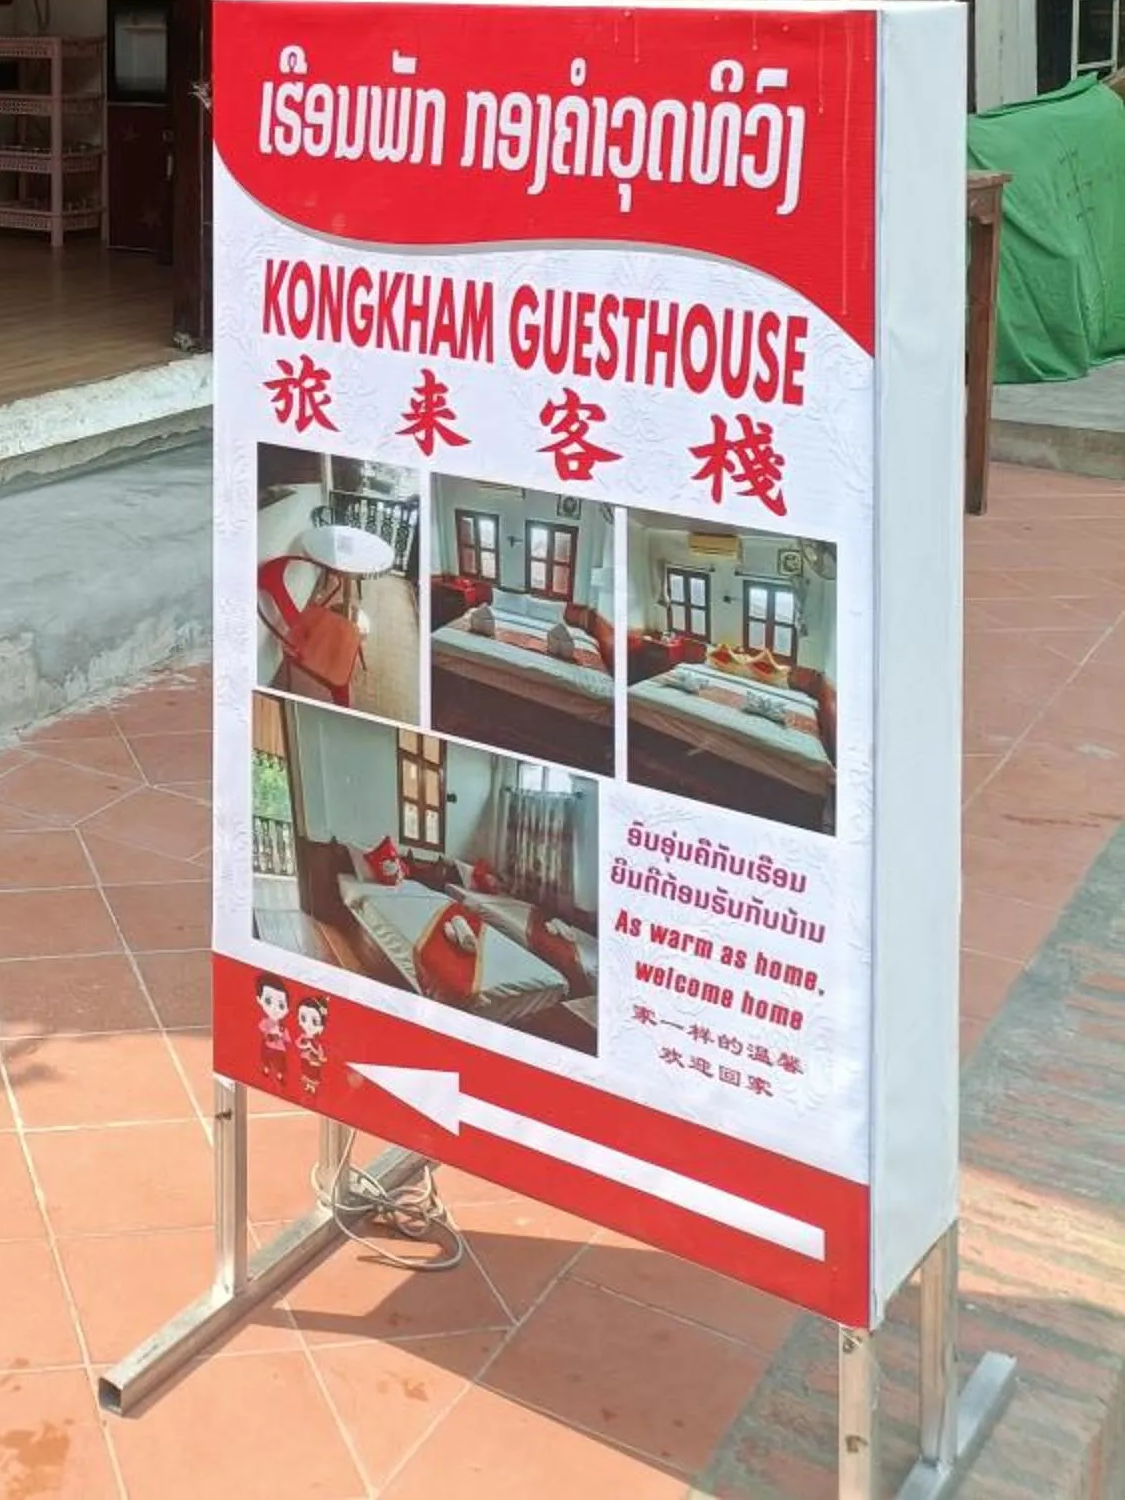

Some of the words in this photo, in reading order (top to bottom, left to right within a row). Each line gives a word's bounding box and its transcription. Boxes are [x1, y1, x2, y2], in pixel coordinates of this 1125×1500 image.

[262, 258, 495, 363] KONGKHAM
[509, 285, 809, 406] GUESTHOUSE
[614, 908, 642, 937] As
[650, 923, 714, 960] warm
[720, 945, 748, 969] as
[635, 960, 734, 1009] welcome
[741, 989, 804, 1031] home
